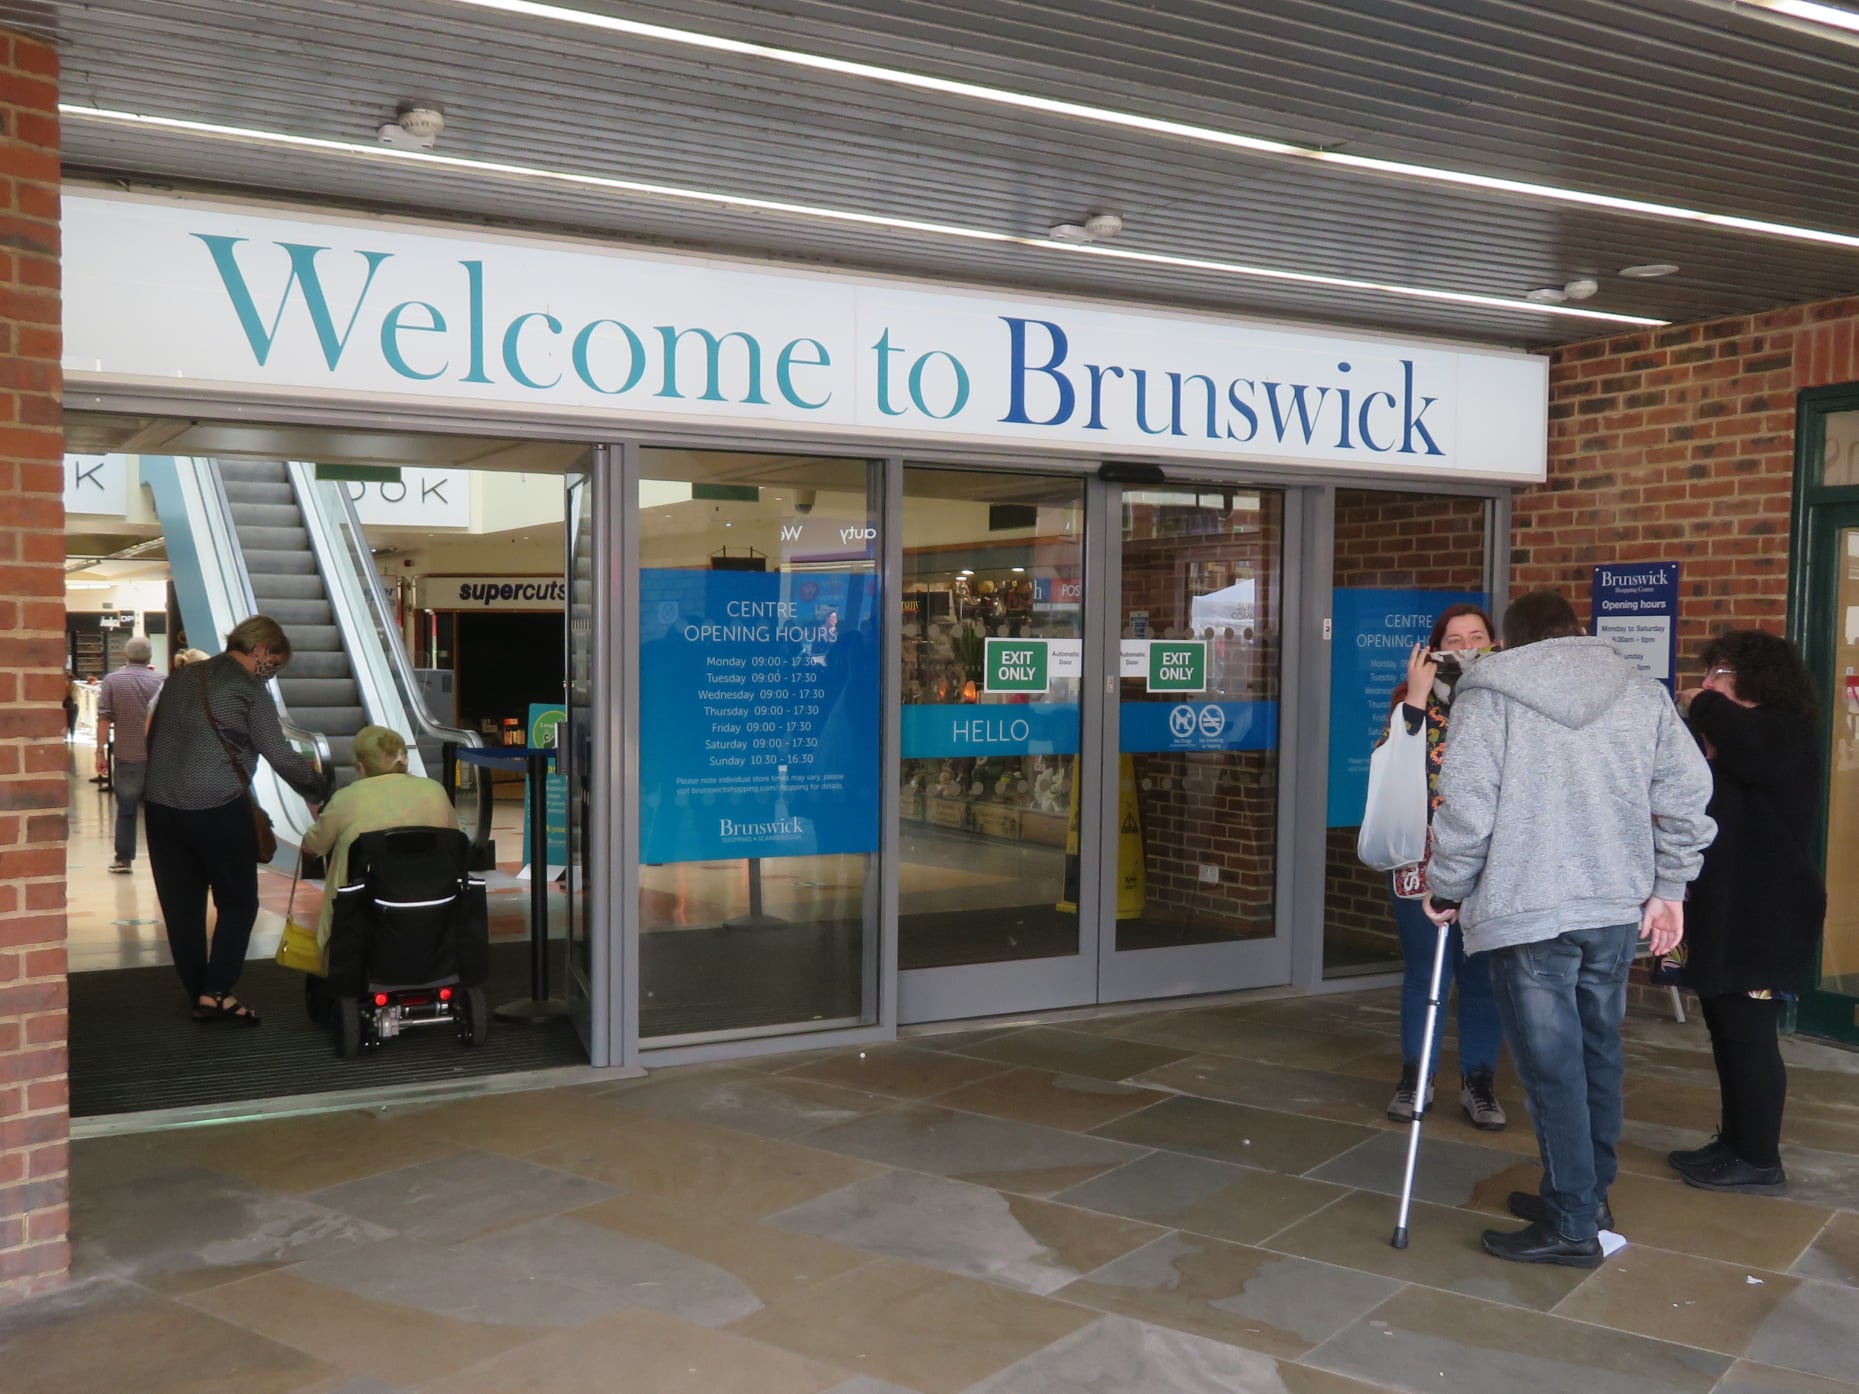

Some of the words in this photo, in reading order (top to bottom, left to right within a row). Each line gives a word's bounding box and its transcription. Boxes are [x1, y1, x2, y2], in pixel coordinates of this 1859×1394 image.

[188, 232, 833, 409] Welcome
[870, 326, 970, 419] to
[997, 316, 1447, 456] Brunswick
[1601, 569, 1668, 586] Brunswick
[459, 580, 565, 605] supercuts
[727, 600, 798, 618] CENTRE
[1602, 600, 1638, 611] Opening
[1640, 600, 1666, 609] hours
[1385, 614, 1433, 628] CENTRE
[684, 625, 770, 643] OPENING
[776, 625, 838, 643] HOURS
[1356, 634, 1414, 648] OPENING
[707, 656, 747, 668] Monday
[1001, 651, 1033, 665] EXIT
[1162, 652, 1192, 665] EXIT
[707, 673, 747, 685] Tuesday
[998, 667, 1036, 681] ONLY
[1160, 667, 1194, 681] ONLY
[698, 690, 755, 701] Wednesday
[704, 706, 749, 718] Thursday
[712, 722, 741, 734] Friday
[953, 719, 1030, 743] HELLO
[705, 739, 747, 751] Saturday
[709, 756, 745, 767] Sunday
[720, 816, 803, 837] Brunswick
